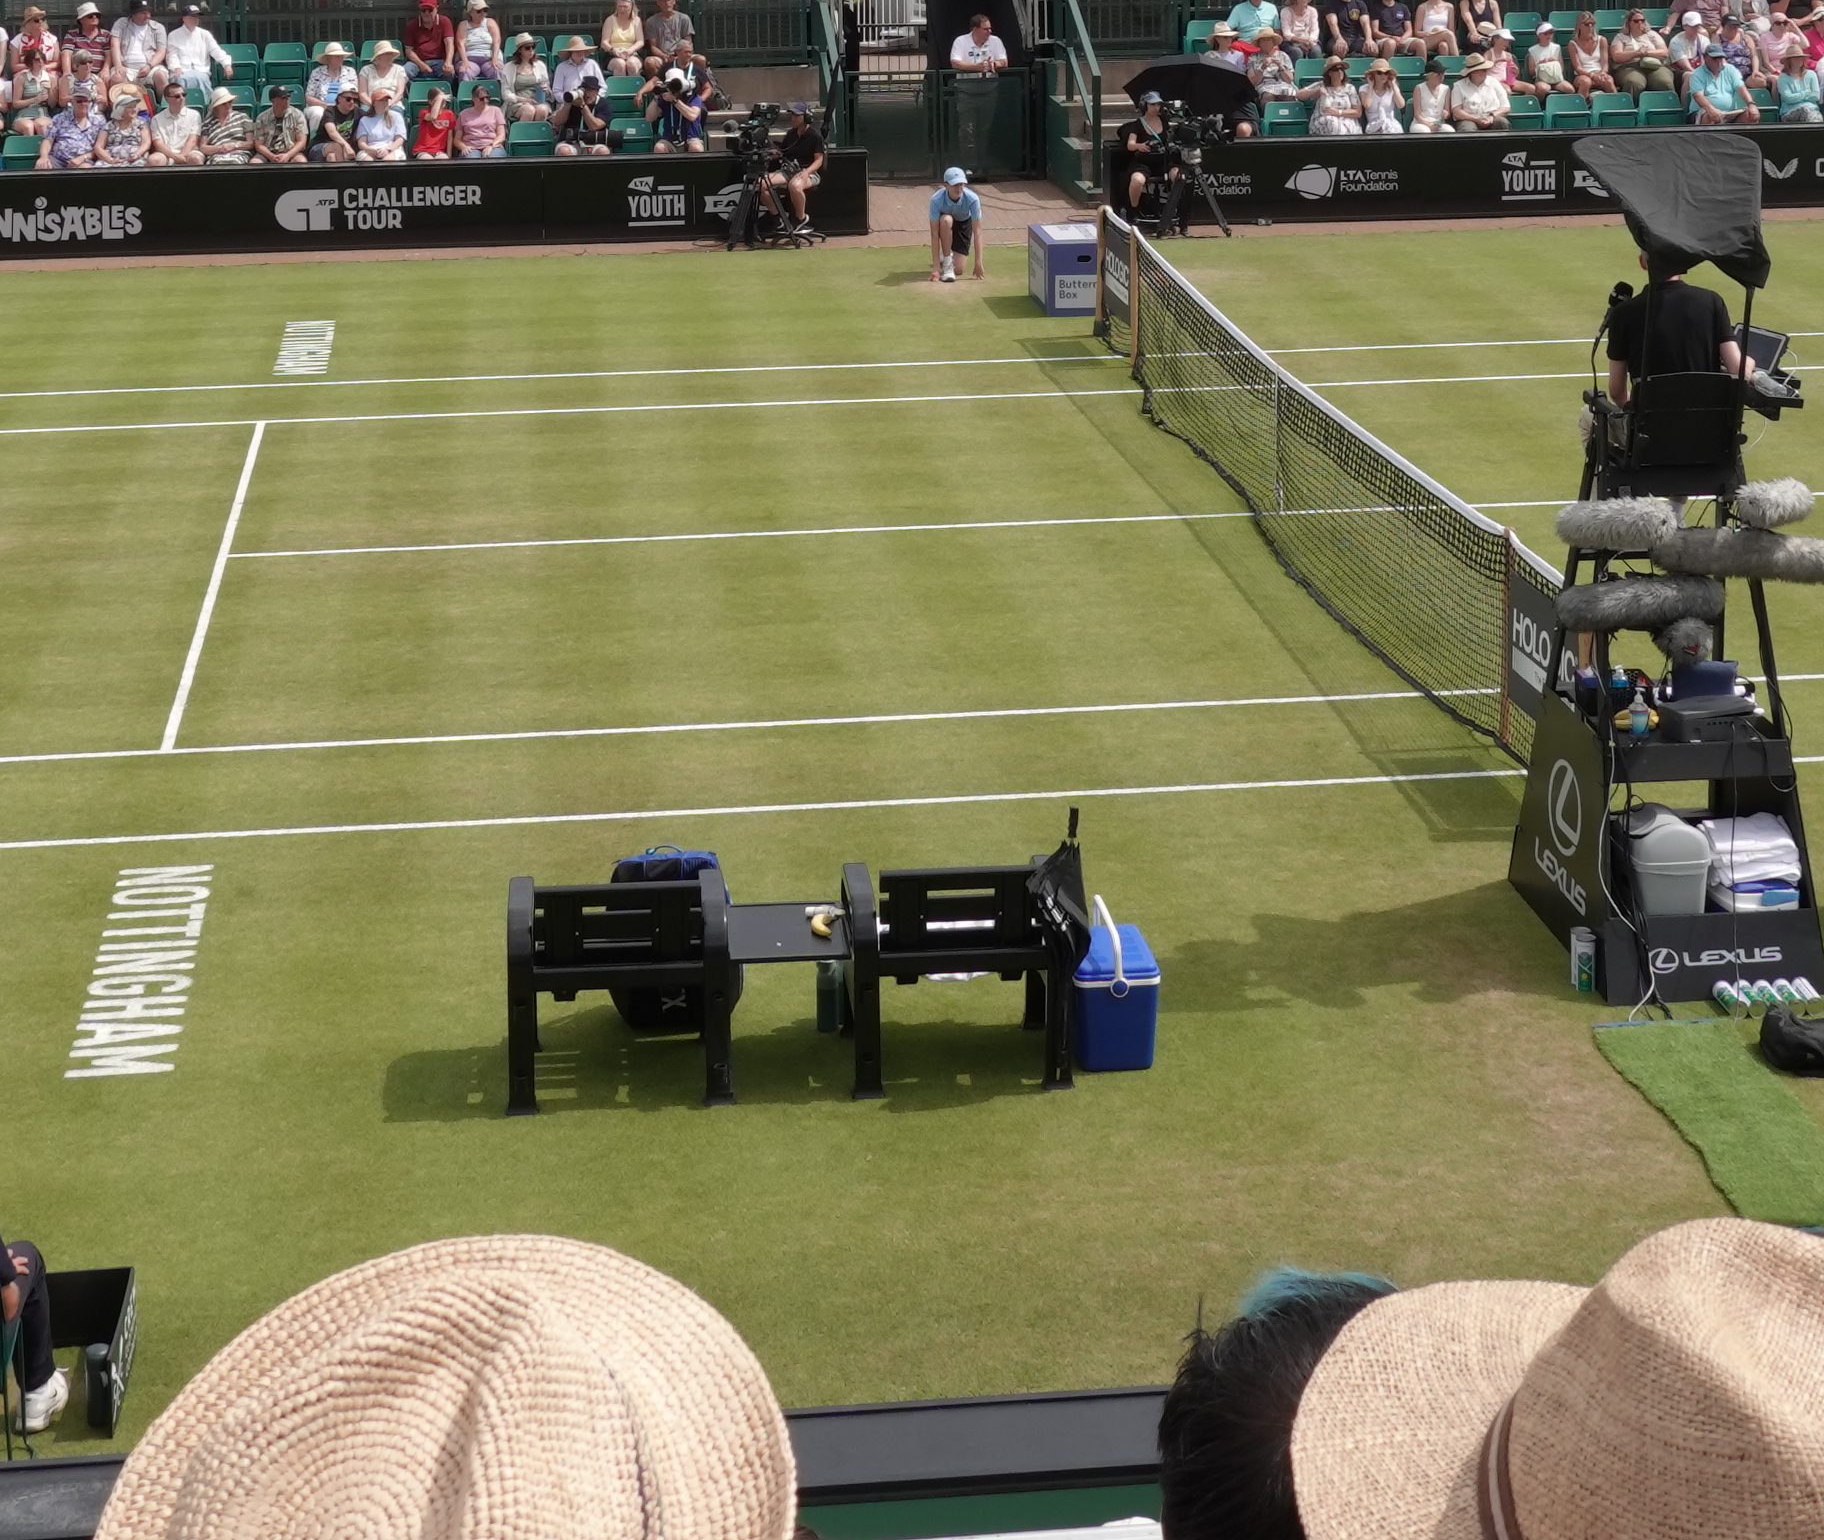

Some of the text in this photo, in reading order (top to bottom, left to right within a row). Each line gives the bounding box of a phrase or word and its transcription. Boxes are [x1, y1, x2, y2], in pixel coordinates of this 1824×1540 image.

[1217, 173, 1252, 184] Tennis
[1340, 169, 1399, 182] LTA Tennis
[1340, 180, 1399, 192] Foundation
[1501, 169, 1556, 192] YOUTH
[315, 199, 336, 207] ATP
[343, 185, 483, 209] CHALLENGER
[627, 193, 686, 218] YOUTH
[344, 208, 403, 230] TOUR
[1106, 247, 1130, 288] HOLOGIC
[1059, 290, 1078, 299] Box
[1513, 608, 1576, 683] HOLOIC
[1535, 836, 1587, 917] LEXUS
[1682, 946, 1783, 967] LEXUS
[63, 864, 214, 1079] NOTTINGHAM
